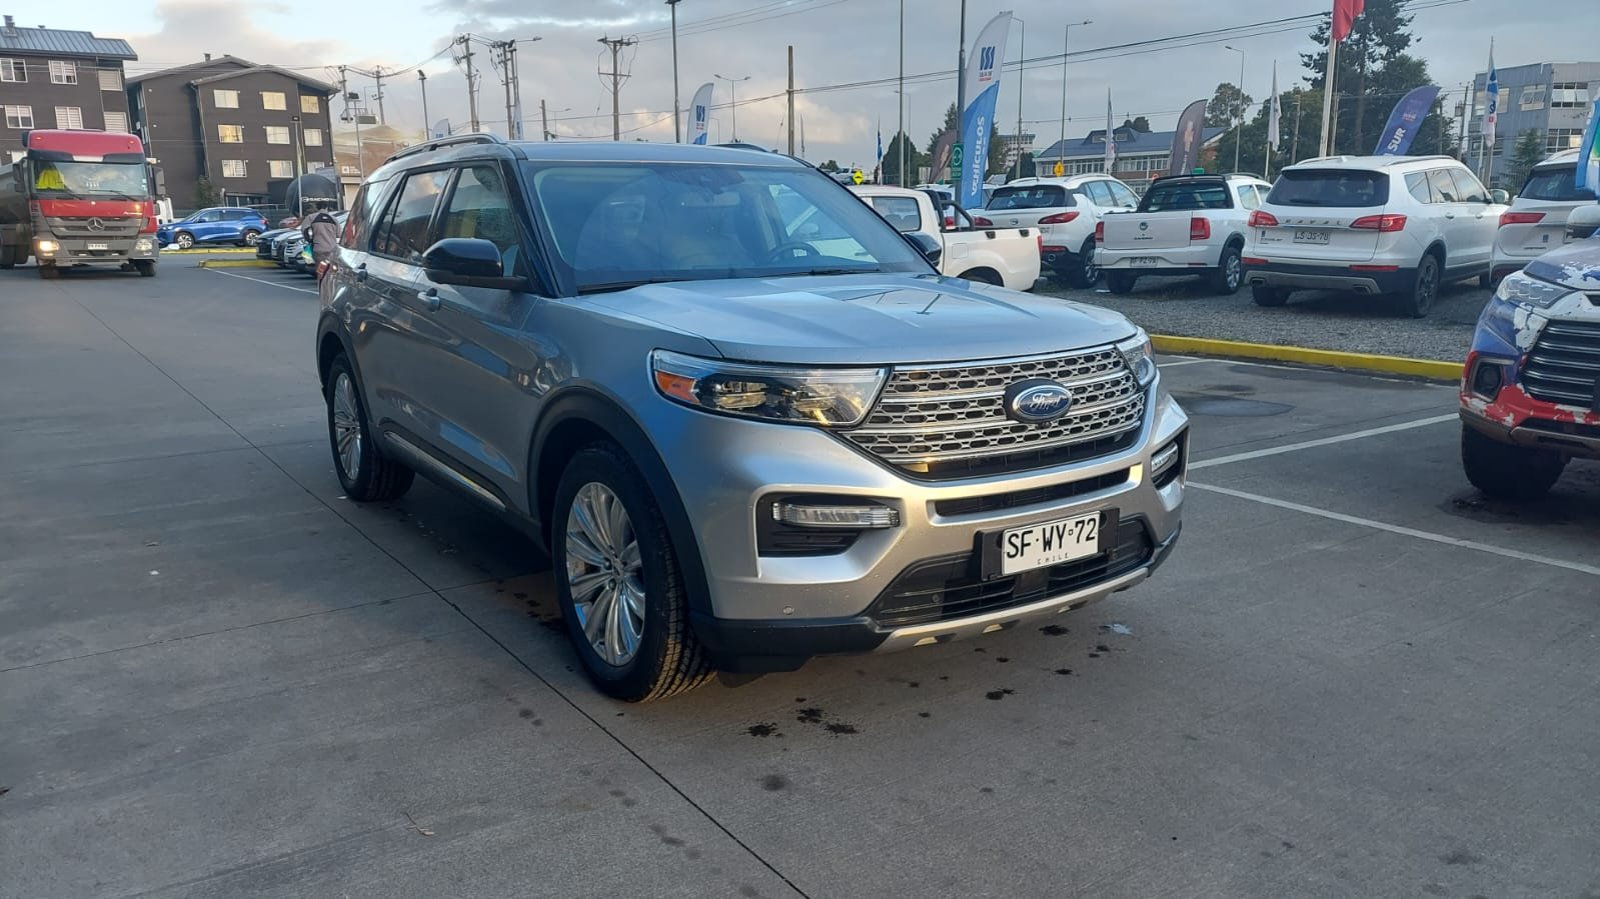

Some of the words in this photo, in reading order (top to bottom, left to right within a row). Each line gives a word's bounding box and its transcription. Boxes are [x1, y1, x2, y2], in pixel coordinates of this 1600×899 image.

[1387, 127, 1407, 152] SUR
[1029, 391, 1063, 410] Ford
[1037, 552, 1069, 565] CHILE
